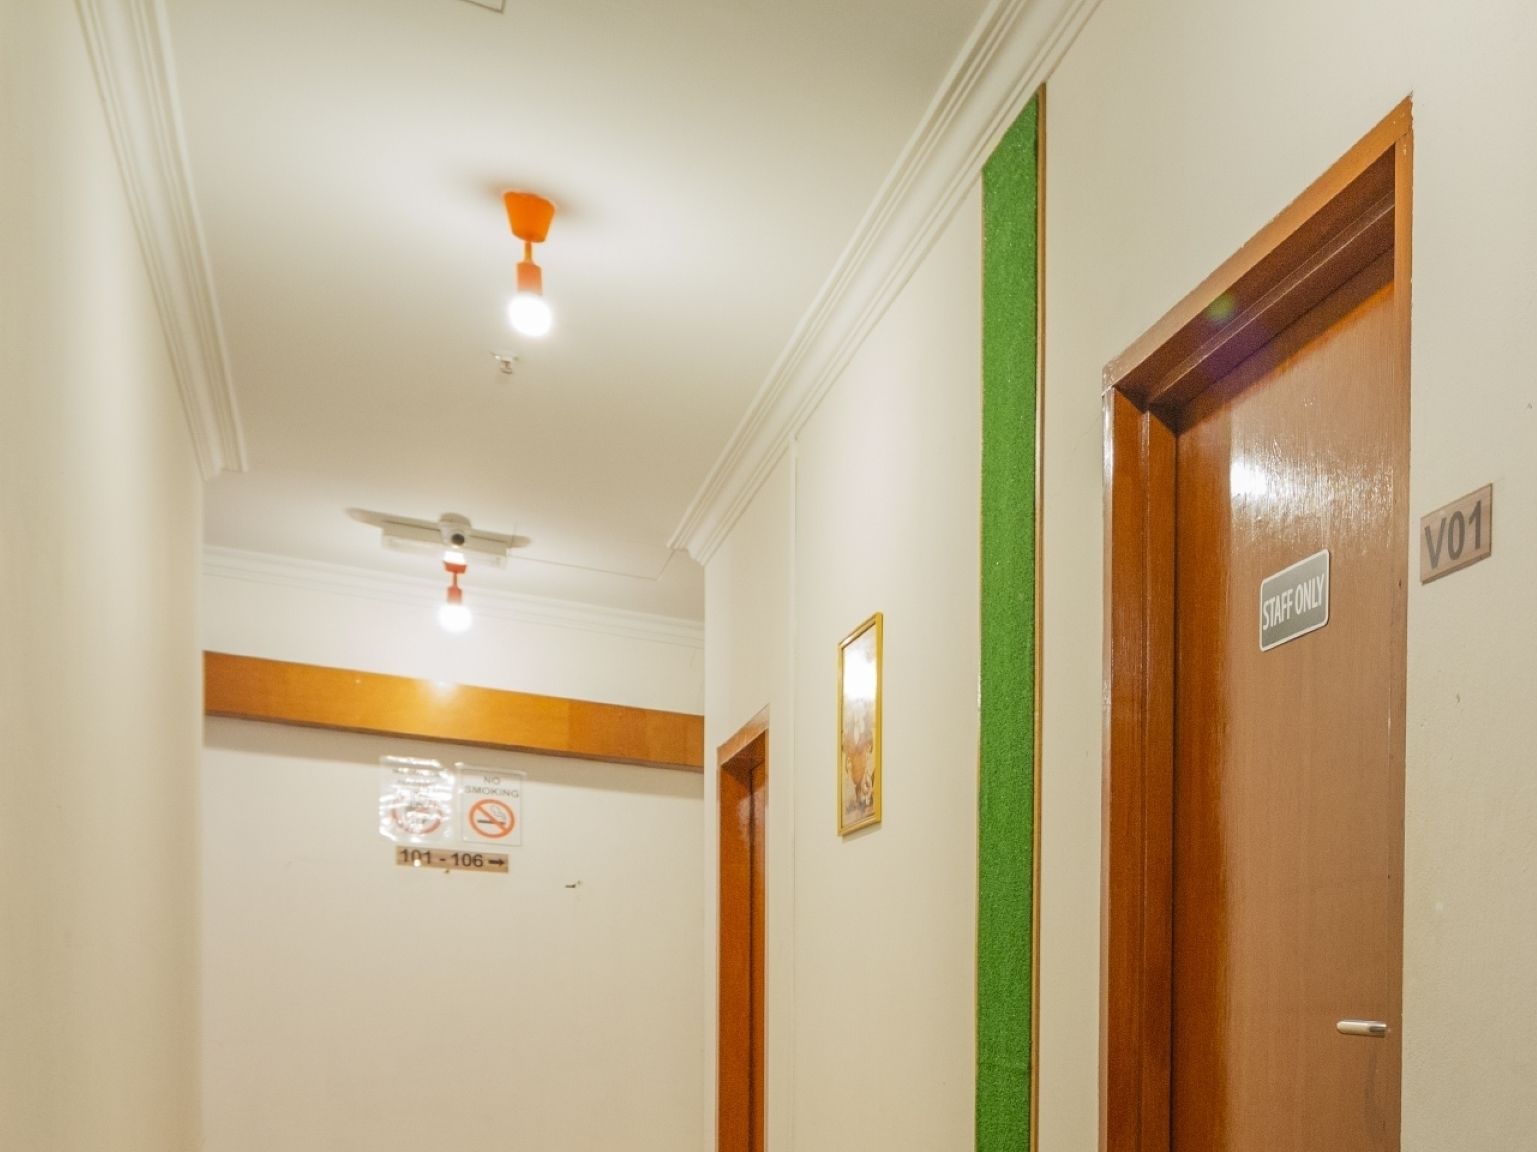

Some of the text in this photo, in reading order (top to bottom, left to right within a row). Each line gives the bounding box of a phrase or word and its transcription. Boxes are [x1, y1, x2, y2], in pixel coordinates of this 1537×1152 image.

[1424, 500, 1483, 570] V01
[1262, 573, 1325, 631] STAFF ONLY
[484, 776, 501, 785] NO
[465, 785, 520, 798] SMOKING
[399, 847, 433, 865] 101
[451, 852, 484, 868] 106
